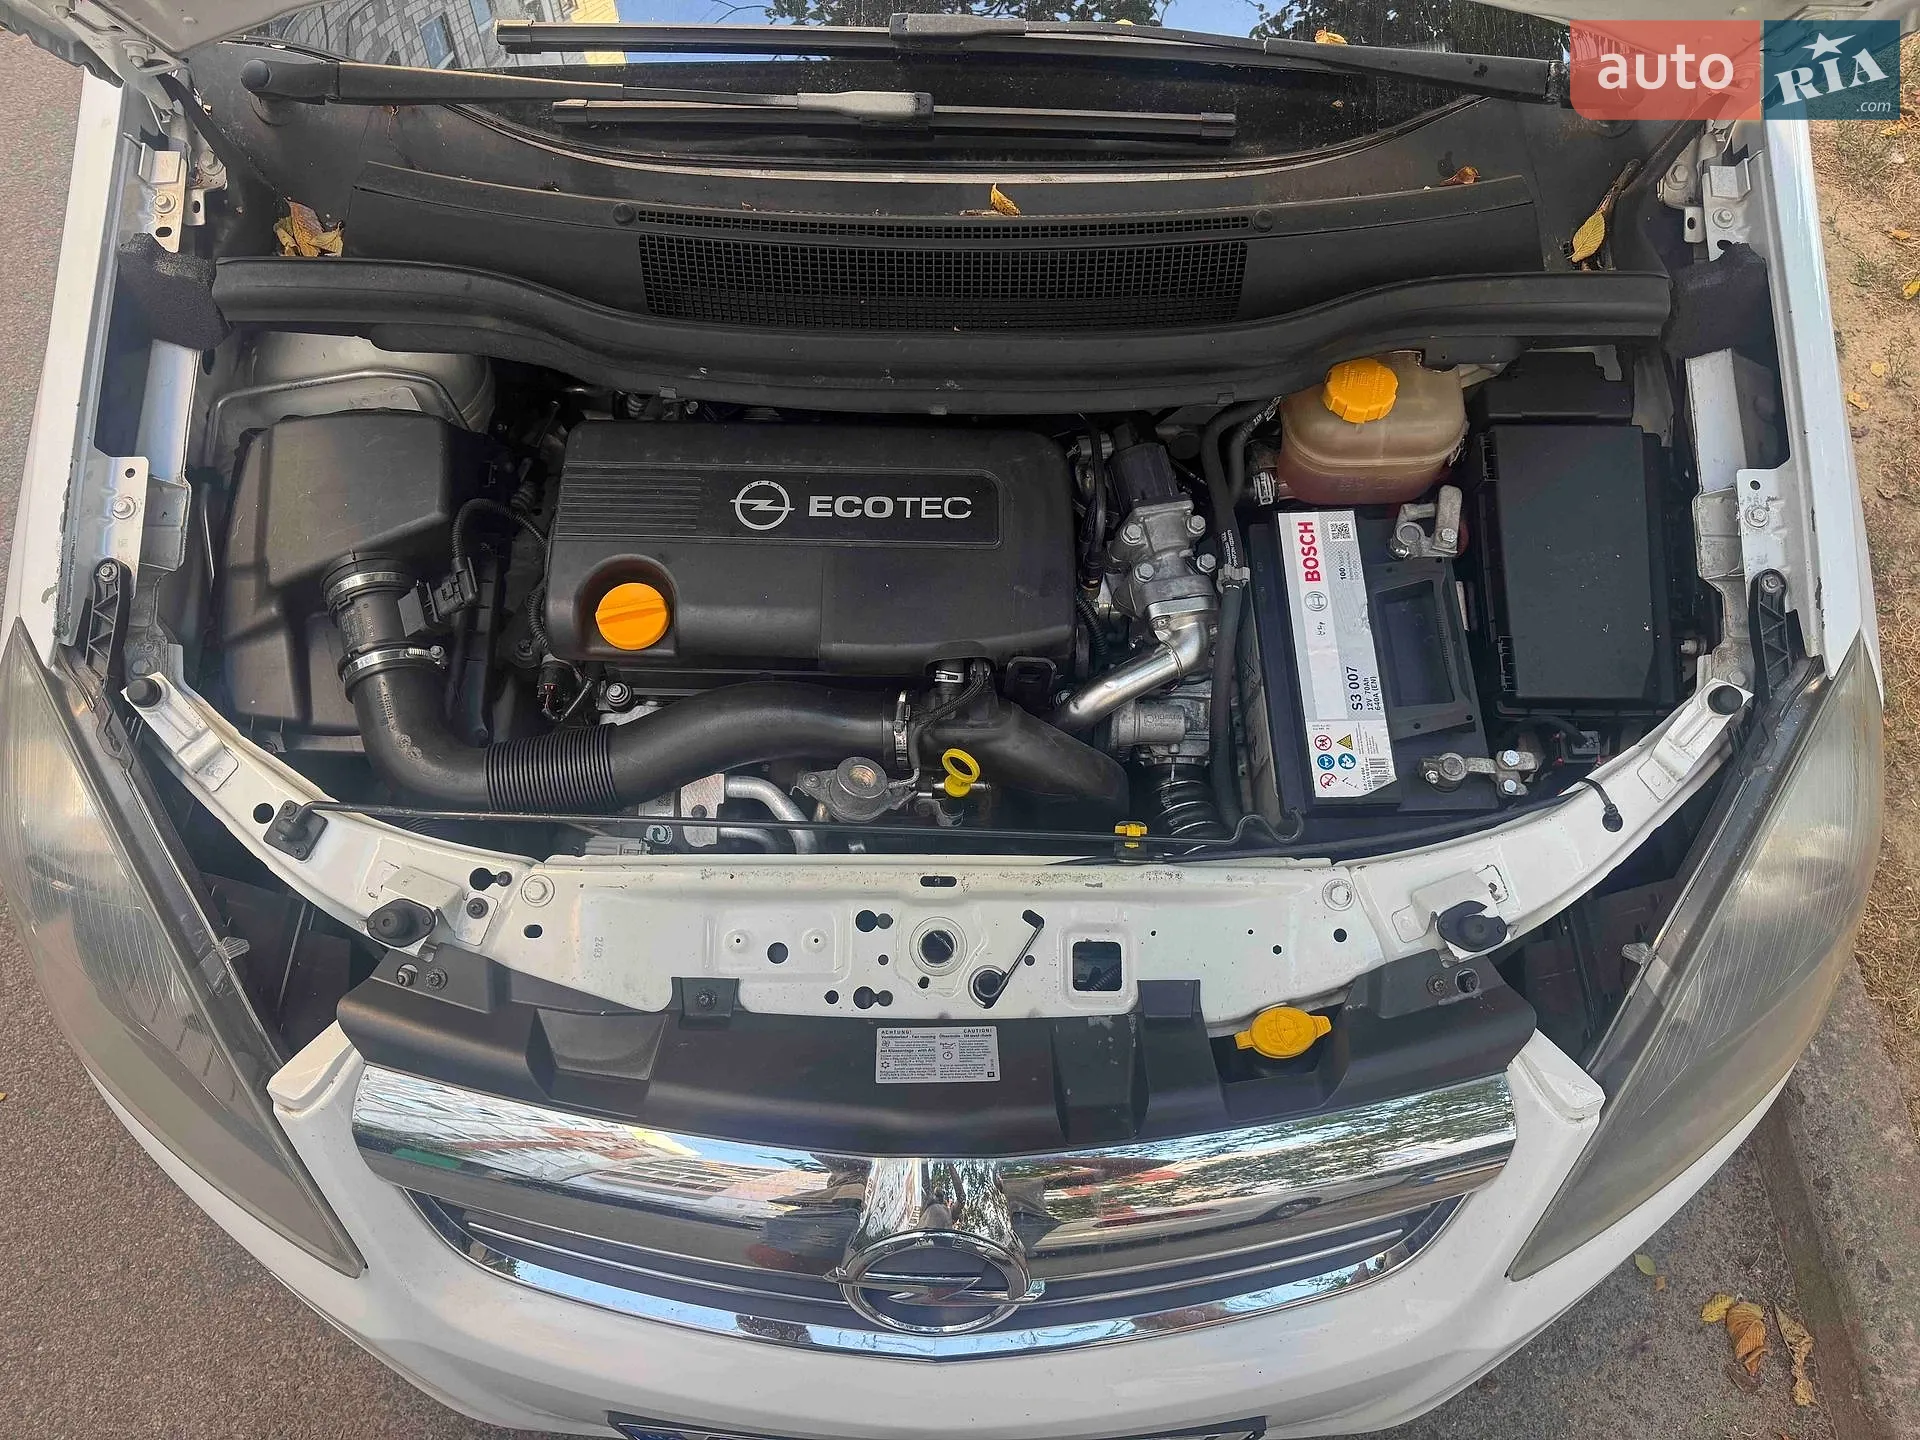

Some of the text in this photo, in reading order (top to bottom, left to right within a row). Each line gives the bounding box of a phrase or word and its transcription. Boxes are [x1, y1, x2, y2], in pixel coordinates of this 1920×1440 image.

[808, 495, 972, 519] ECOTEC
[1297, 521, 1322, 582] BOSCH
[1346, 666, 1363, 711] S3 007
[1363, 677, 1374, 710] 12V 70Ah
